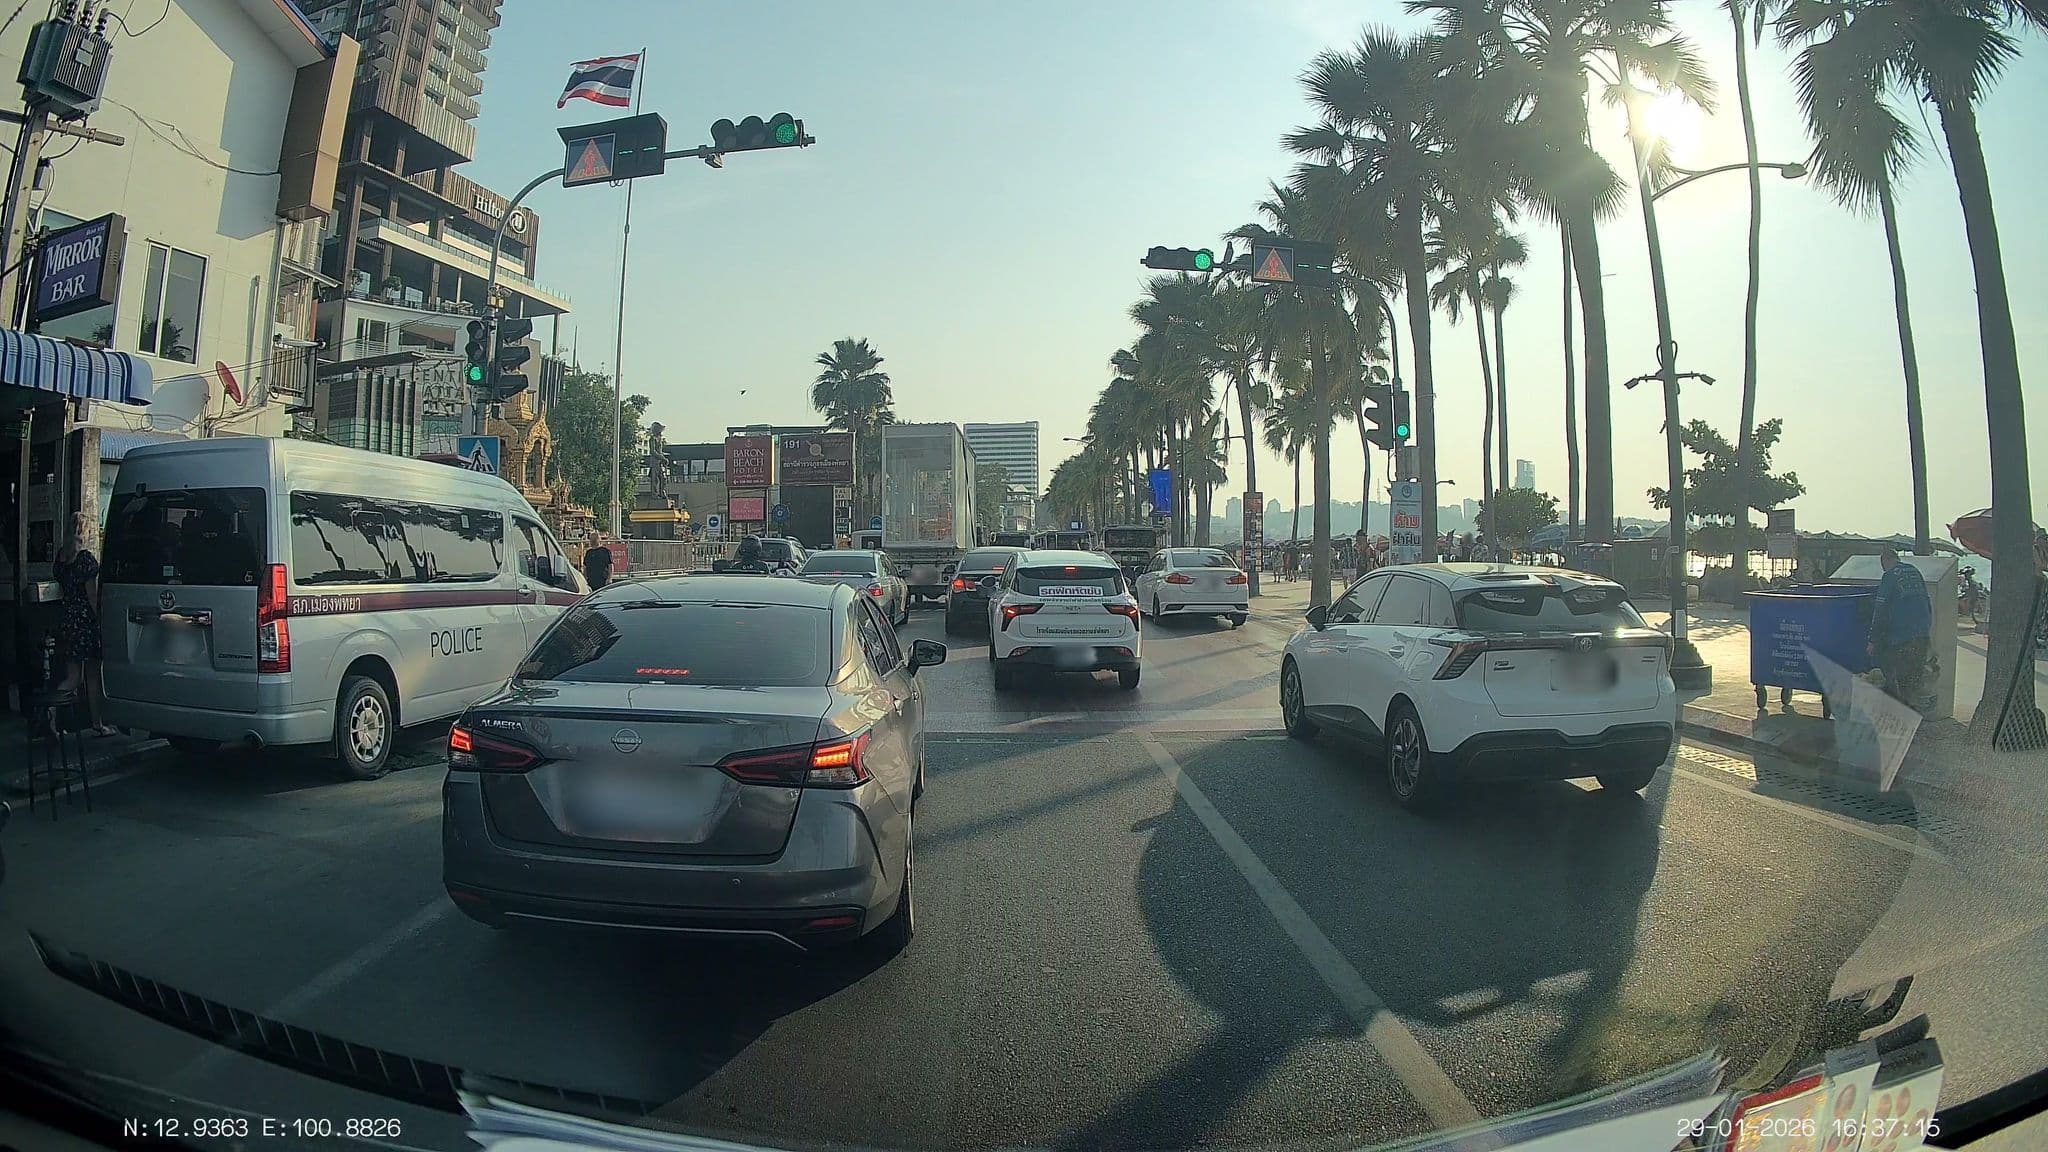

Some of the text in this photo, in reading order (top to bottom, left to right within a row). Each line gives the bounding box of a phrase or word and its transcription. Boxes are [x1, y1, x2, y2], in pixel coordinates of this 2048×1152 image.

[42, 235, 102, 282] MIRROR
[50, 274, 86, 303] BAR
[783, 439, 800, 449] 191
[733, 448, 764, 458] BARON
[733, 458, 764, 467] BEACH
[430, 627, 482, 657] POLICE
[480, 718, 523, 731] ALMERA
